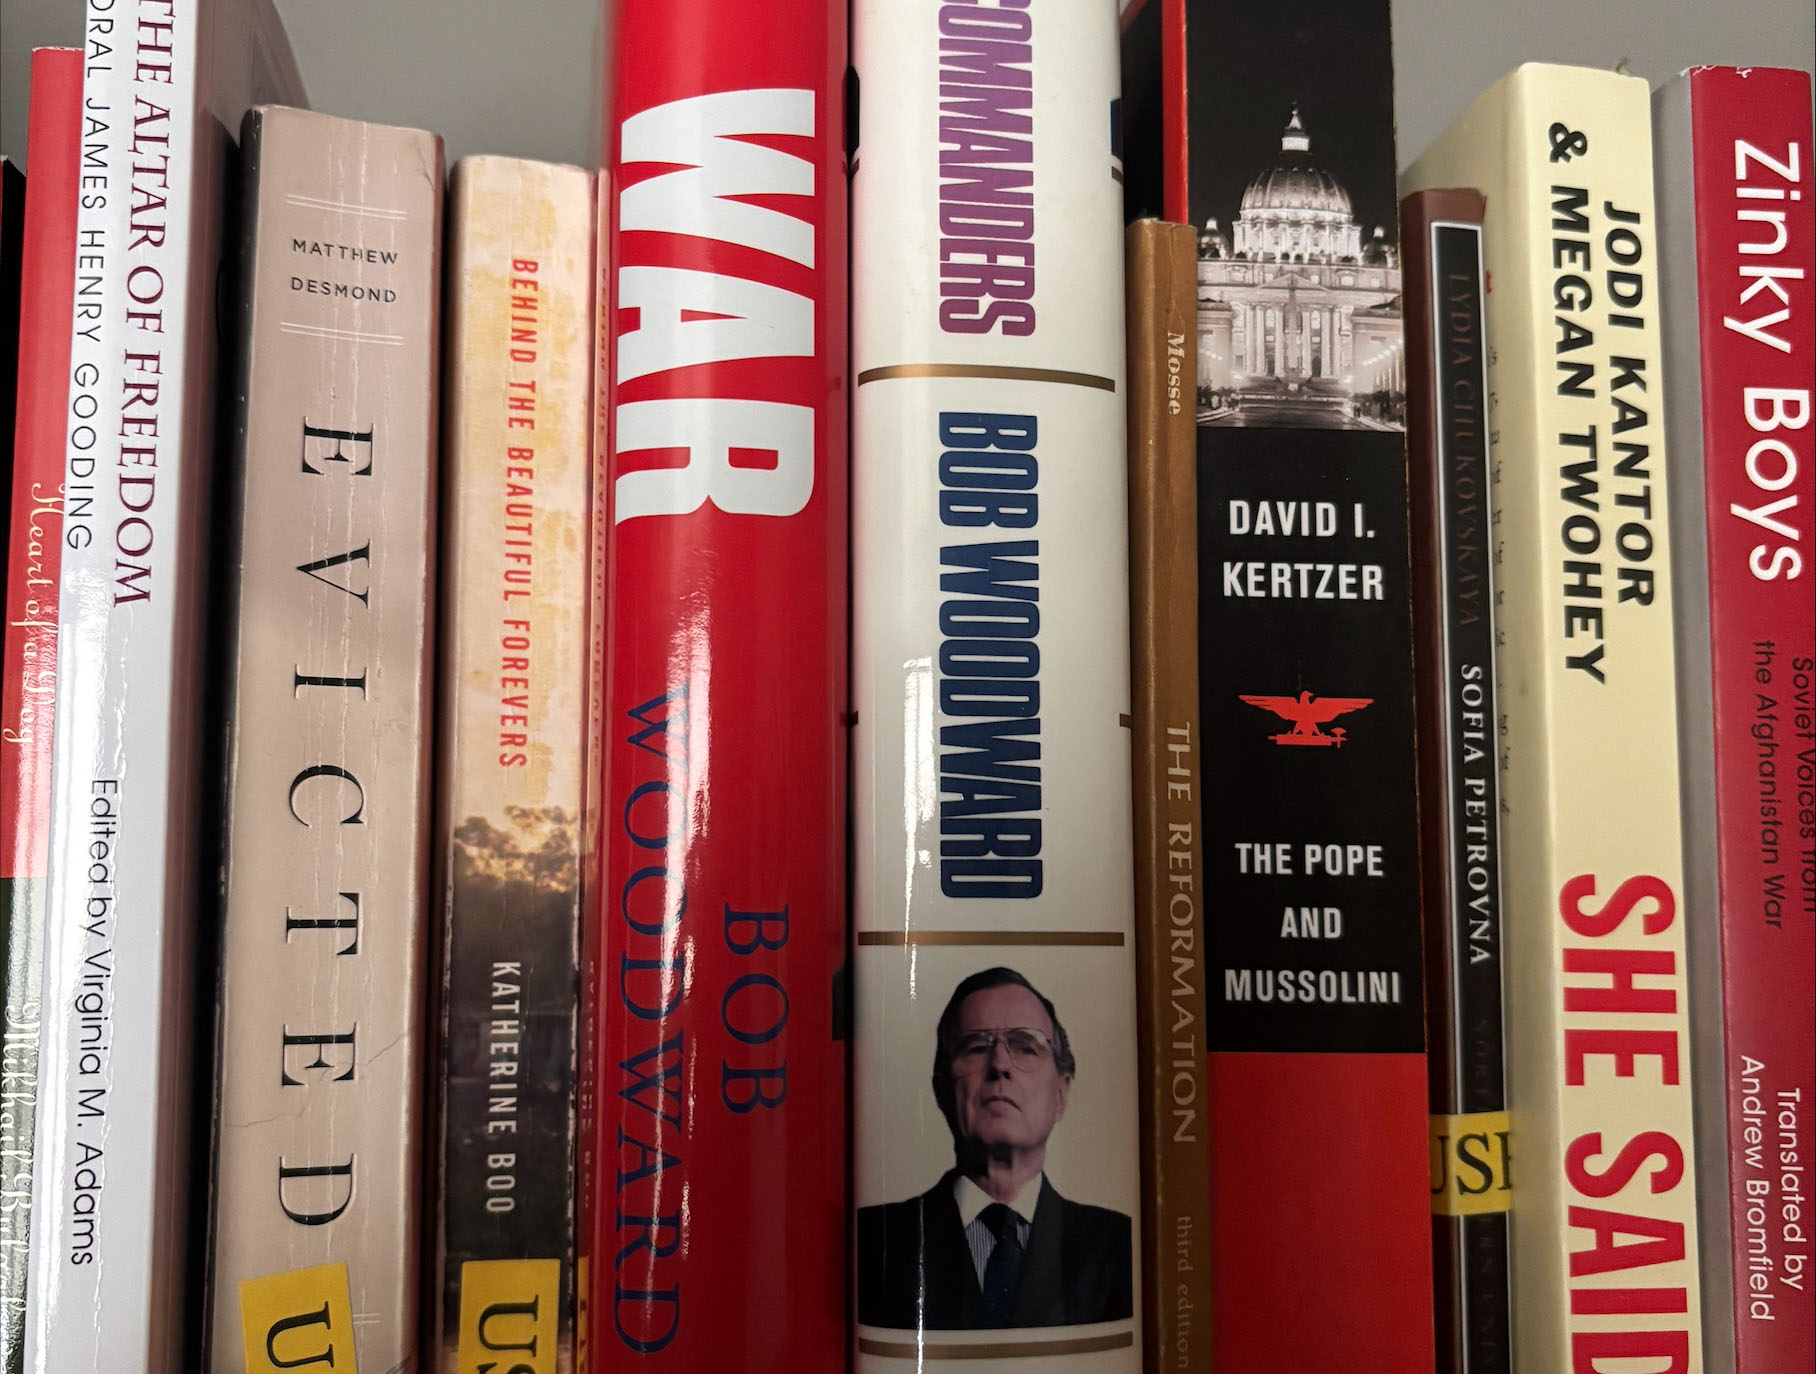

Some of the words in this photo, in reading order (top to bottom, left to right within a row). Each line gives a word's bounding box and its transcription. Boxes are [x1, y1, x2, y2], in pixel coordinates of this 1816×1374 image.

[133, 0, 174, 84] THE
[81, 97, 111, 209] JAMES
[128, 94, 171, 251] ALTAR
[935, 0, 1036, 335] OMMANDERS
[1548, 122, 1589, 164] &
[74, 229, 106, 343] HENRY
[125, 266, 164, 333] OF
[290, 277, 397, 303] DESMOND
[292, 239, 399, 265] MATTHEW
[1550, 184, 1596, 399] MEGAN
[1602, 200, 1645, 329] JODI
[1723, 139, 1804, 353] Zinky
[510, 259, 538, 363] BEHIND
[615, 88, 815, 526] WAR
[508, 381, 535, 429] THE
[1166, 331, 1185, 415] Mosse
[66, 363, 100, 551] GOODING
[113, 349, 162, 608] FREEDOM
[938, 412, 1038, 528] BOB
[1609, 355, 1654, 607] KANTOR
[1729, 387, 1810, 582] Boys
[27, 482, 66, 594] Heart
[503, 447, 534, 601] BEAUTIFUL
[1229, 500, 1337, 539] DAVID
[1354, 503, 1375, 539] I.
[1557, 424, 1605, 685] TWOHEY
[10, 599, 59, 635] of
[1223, 561, 1384, 600] KERTZER
[3, 669, 57, 745] Dog
[23, 642, 39, 666] a
[499, 619, 531, 767] FOREVERS
[1752, 640, 1775, 684] the
[938, 541, 1043, 900] WOODWARD
[1165, 722, 1192, 801] THE
[1459, 664, 1483, 763] SOFIA
[88, 779, 117, 884] Edited
[278, 415, 375, 1227] EVICTED
[1751, 694, 1782, 864] Afghanistan
[1235, 843, 1292, 875] THE
[1304, 844, 1384, 876] POPE
[1464, 777, 1491, 966] PETROVNA
[1764, 874, 1786, 929] War
[84, 898, 112, 937] by
[1280, 907, 1343, 940] AND
[75, 949, 111, 1075] Virginia
[614, 682, 691, 1353] WOODWARD
[721, 902, 790, 1114] BOB
[1168, 823, 1196, 1143] REFORMATION
[1224, 968, 1401, 1004] MUSSOLINI
[1559, 873, 1680, 1086] SHE
[488, 962, 520, 1133] KATHERINE
[77, 1088, 104, 1128] M.
[1739, 1055, 1771, 1170] Andrew
[1776, 1087, 1806, 1242] Translated
[70, 1141, 103, 1266] Adams
[486, 1153, 514, 1213] BOO
[1176, 1216, 1194, 1272] third
[1563, 1131, 1689, 1374] SAID
[1744, 1179, 1775, 1320] Bromfield
[1779, 1253, 1808, 1291] by
[1176, 1283, 1194, 1369] edition
